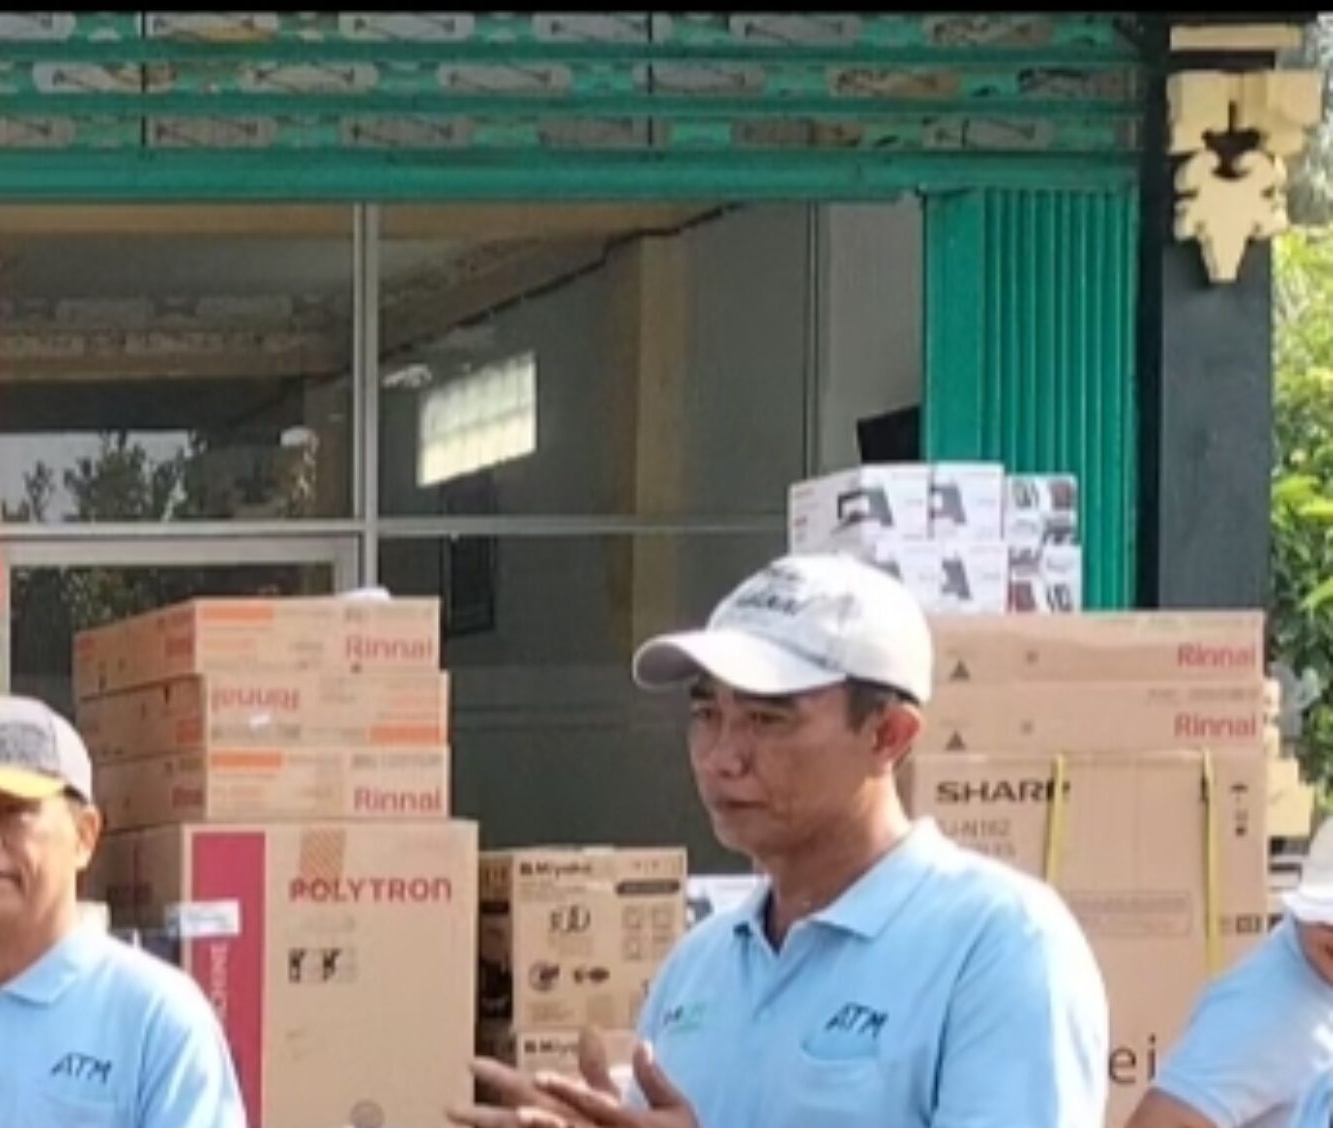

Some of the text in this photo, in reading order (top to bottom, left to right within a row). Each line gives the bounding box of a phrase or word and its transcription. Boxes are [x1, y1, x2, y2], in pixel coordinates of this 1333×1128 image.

[1176, 642, 1255, 668] Rinnai
[1174, 711, 1256, 738] Rinnai
[354, 785, 442, 813] Rinnai
[936, 780, 1071, 803] SHARP
[289, 877, 453, 902] POLYTRON
[825, 1002, 889, 1038] ATM
[50, 1051, 113, 1085] ATM
[1108, 1033, 1157, 1085] ei
